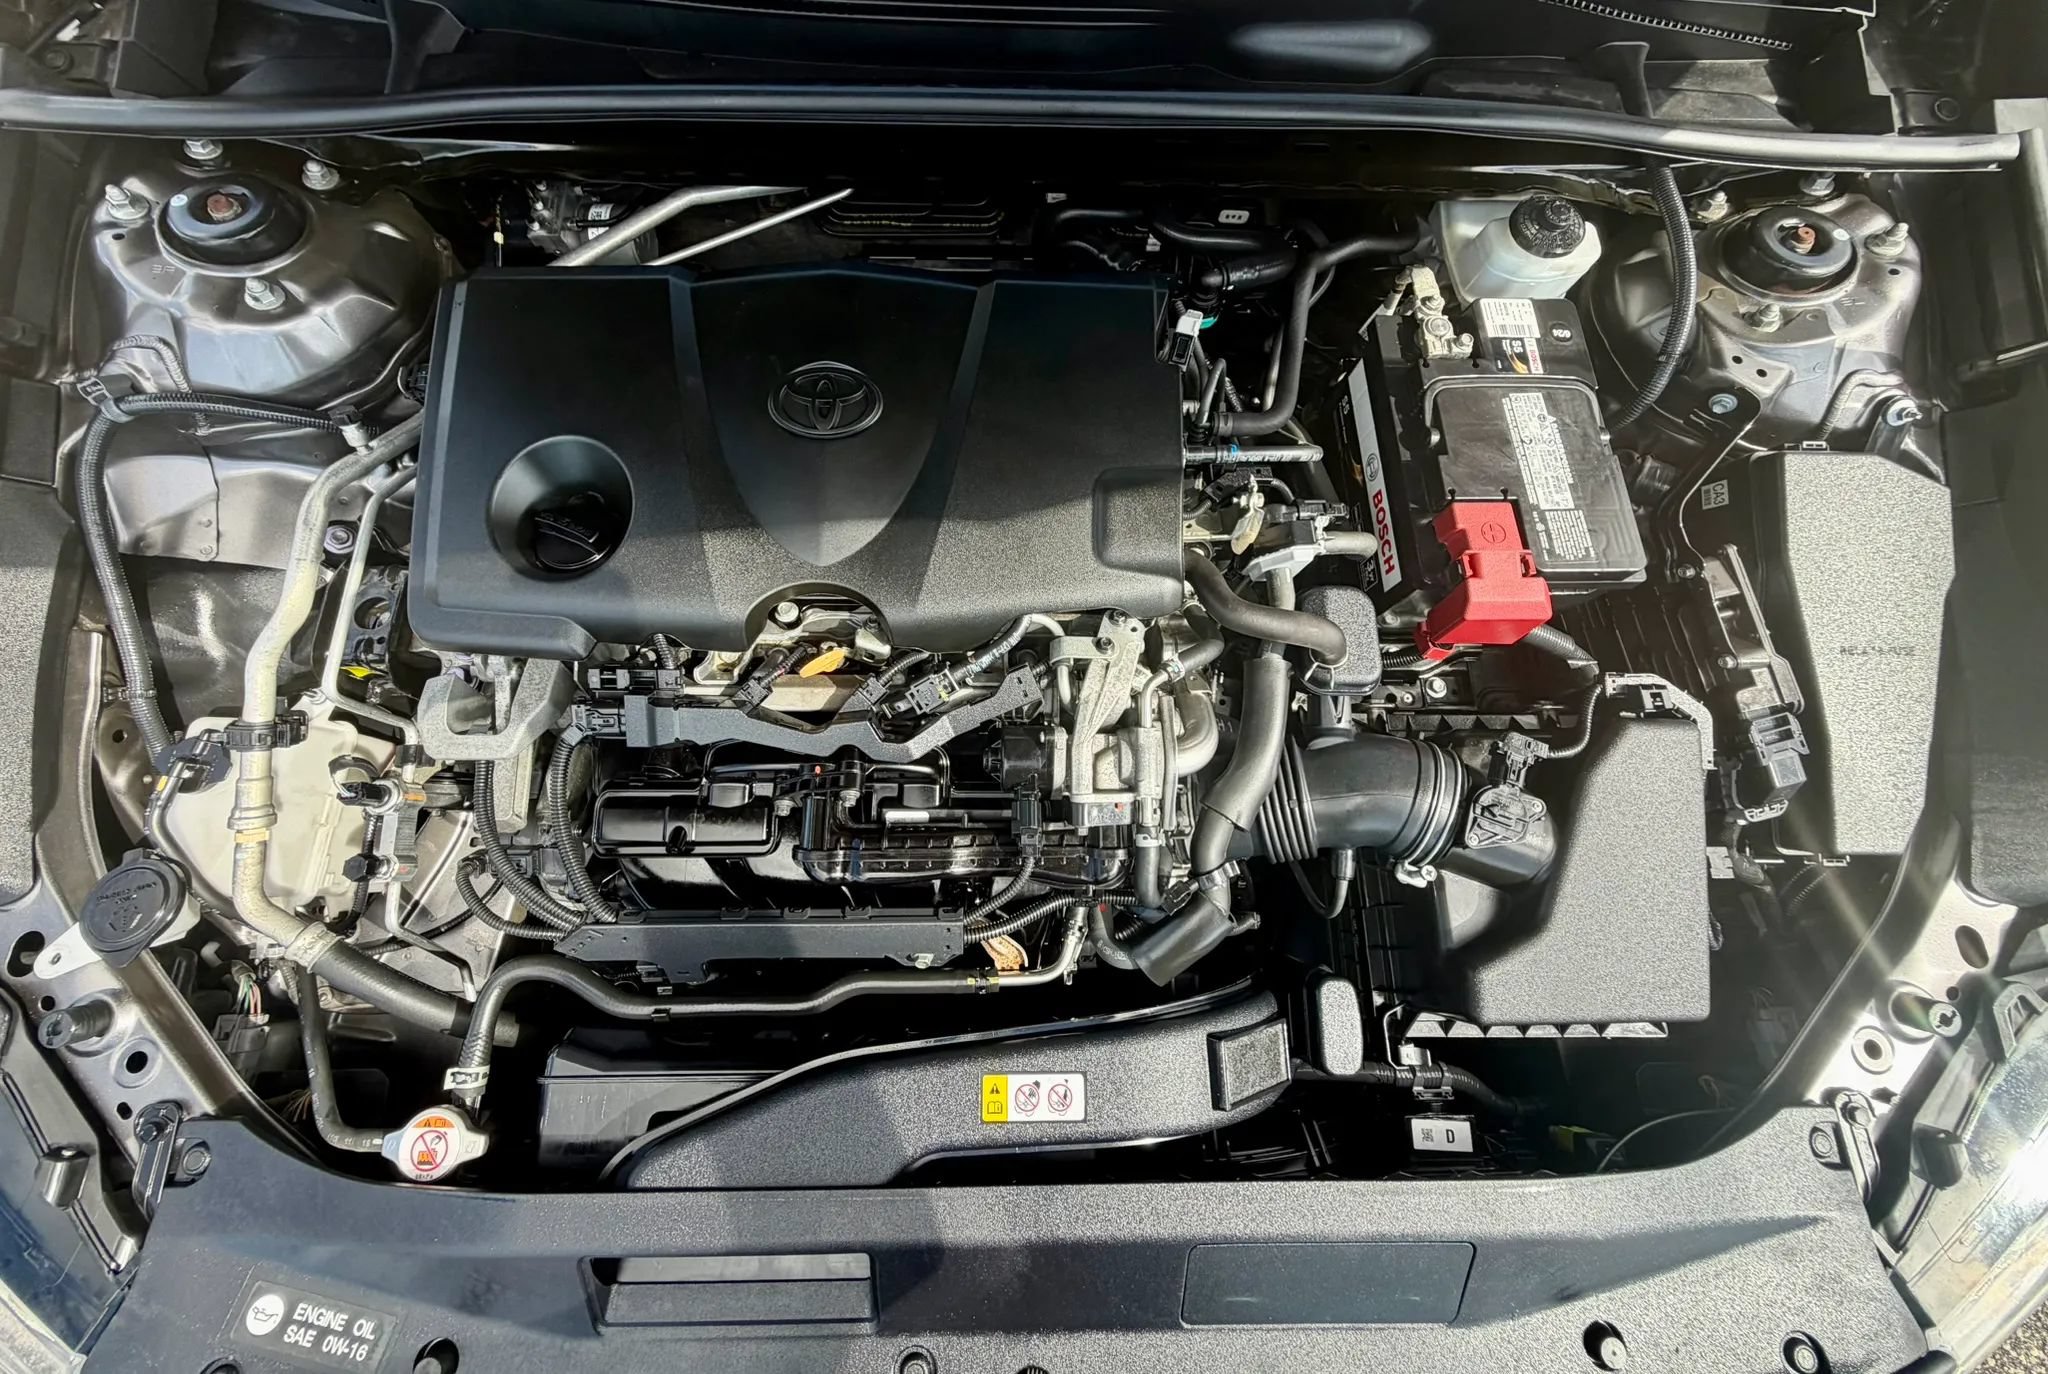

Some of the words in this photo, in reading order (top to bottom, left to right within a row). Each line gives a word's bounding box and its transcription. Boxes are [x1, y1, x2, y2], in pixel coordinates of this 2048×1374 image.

[1511, 340, 1524, 353] S5
[1529, 349, 1541, 372] BOSCH
[1712, 483, 1726, 506] CA3
[1371, 488, 1396, 576] BOSCH
[1445, 1128, 1456, 1144] D
[292, 1302, 348, 1332] ENGINE
[352, 1318, 377, 1340] OIL
[283, 1324, 317, 1348] SAE
[321, 1334, 369, 1362] 0W-16
